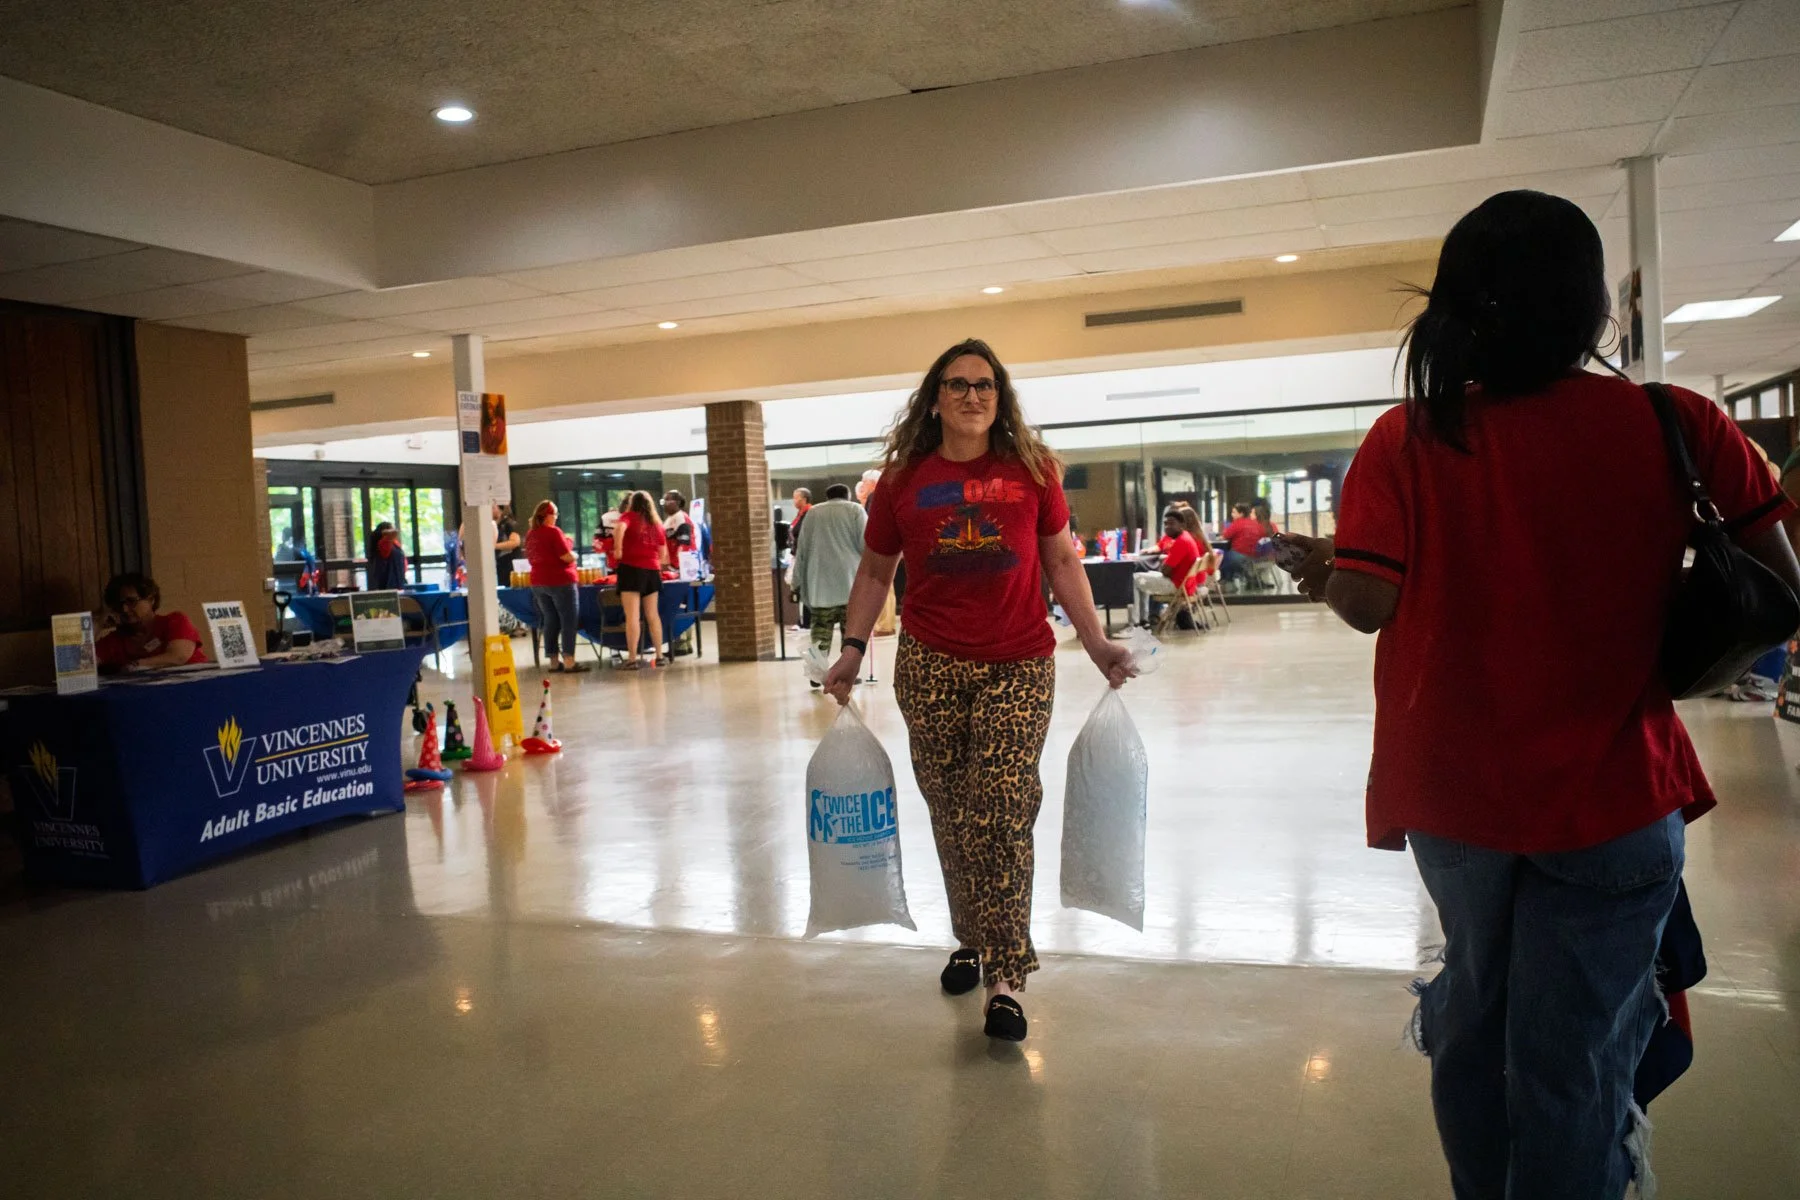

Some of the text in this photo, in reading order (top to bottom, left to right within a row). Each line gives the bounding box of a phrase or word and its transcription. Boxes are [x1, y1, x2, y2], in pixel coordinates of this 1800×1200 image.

[206, 606, 243, 620] SCAN ME
[261, 713, 365, 753] VINCENNES
[256, 741, 369, 785] UNIVERSITY
[316, 764, 372, 783] www.vinu.edu
[200, 780, 373, 843] Adult Basic Education
[822, 794, 860, 814] TWICE
[860, 786, 896, 832] ICE
[839, 815, 862, 834] THE
